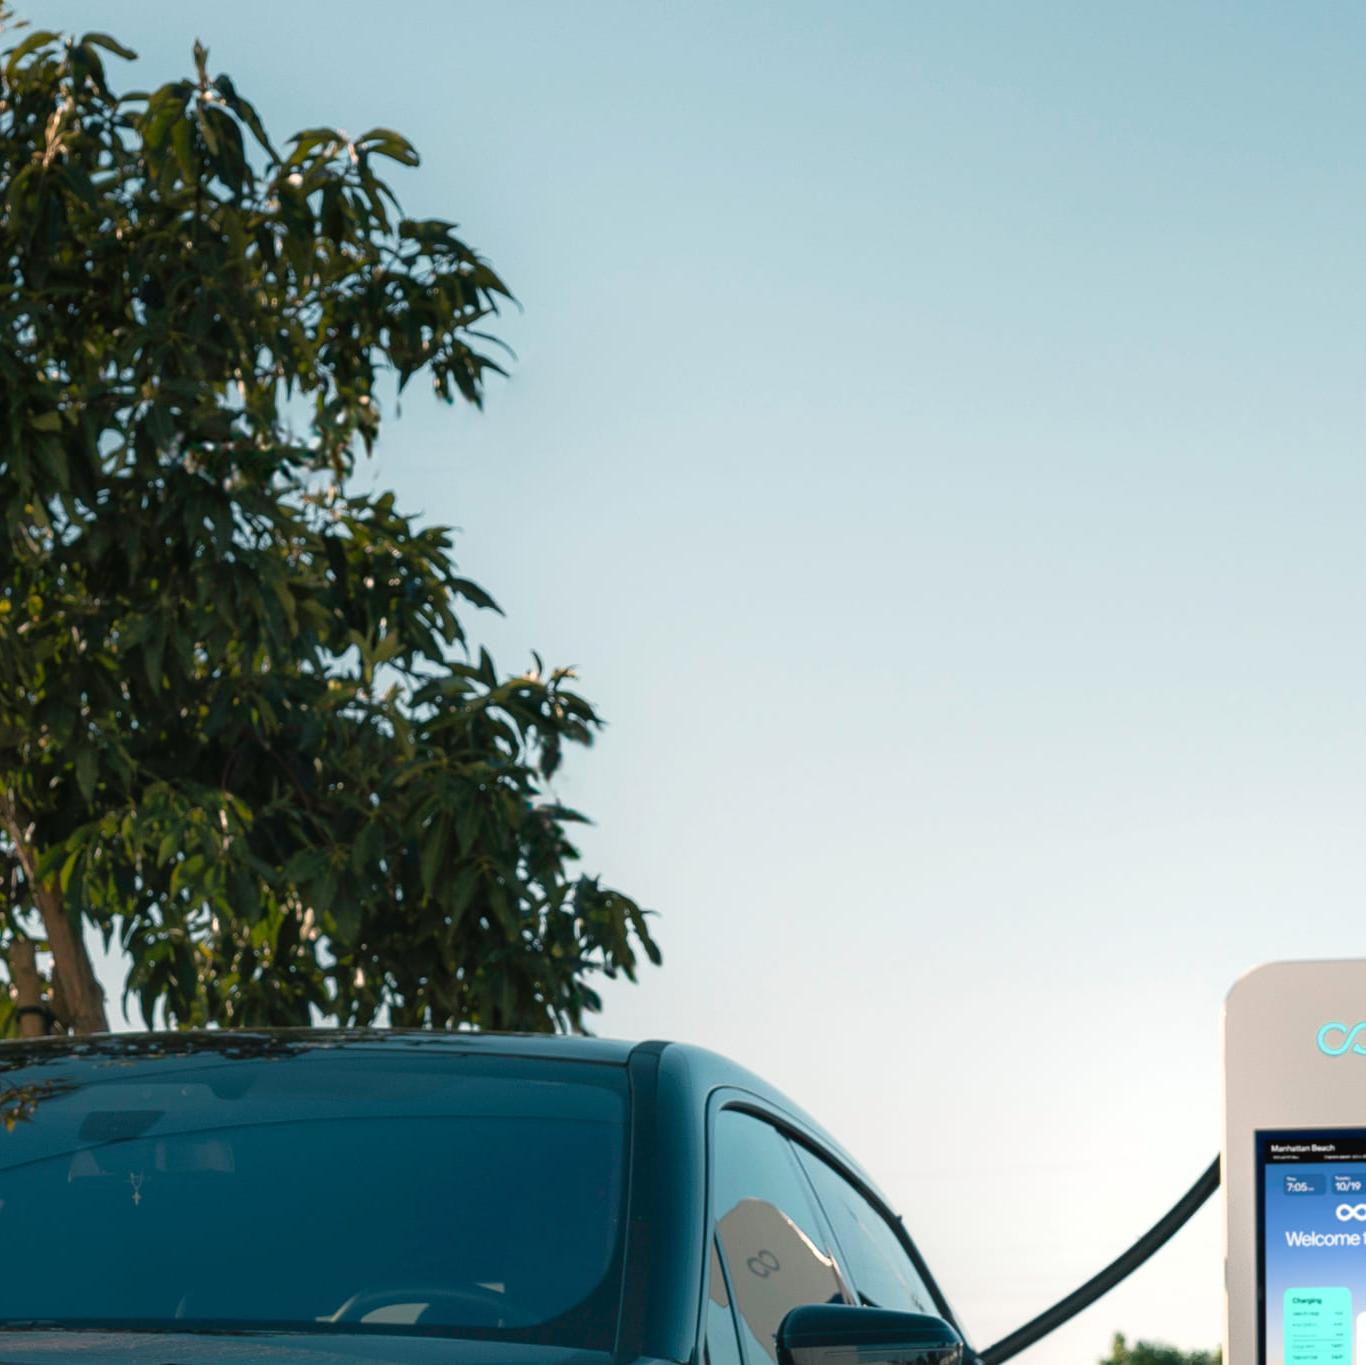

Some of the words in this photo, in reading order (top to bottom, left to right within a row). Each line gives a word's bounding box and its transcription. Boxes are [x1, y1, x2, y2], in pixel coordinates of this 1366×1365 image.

[1270, 1144, 1311, 1153] Manhattan
[1311, 1143, 1336, 1153] Beach
[1286, 1182, 1308, 1193] 7:05
[1335, 1181, 1362, 1193] 10/19
[1285, 1231, 1361, 1248] Welcome
